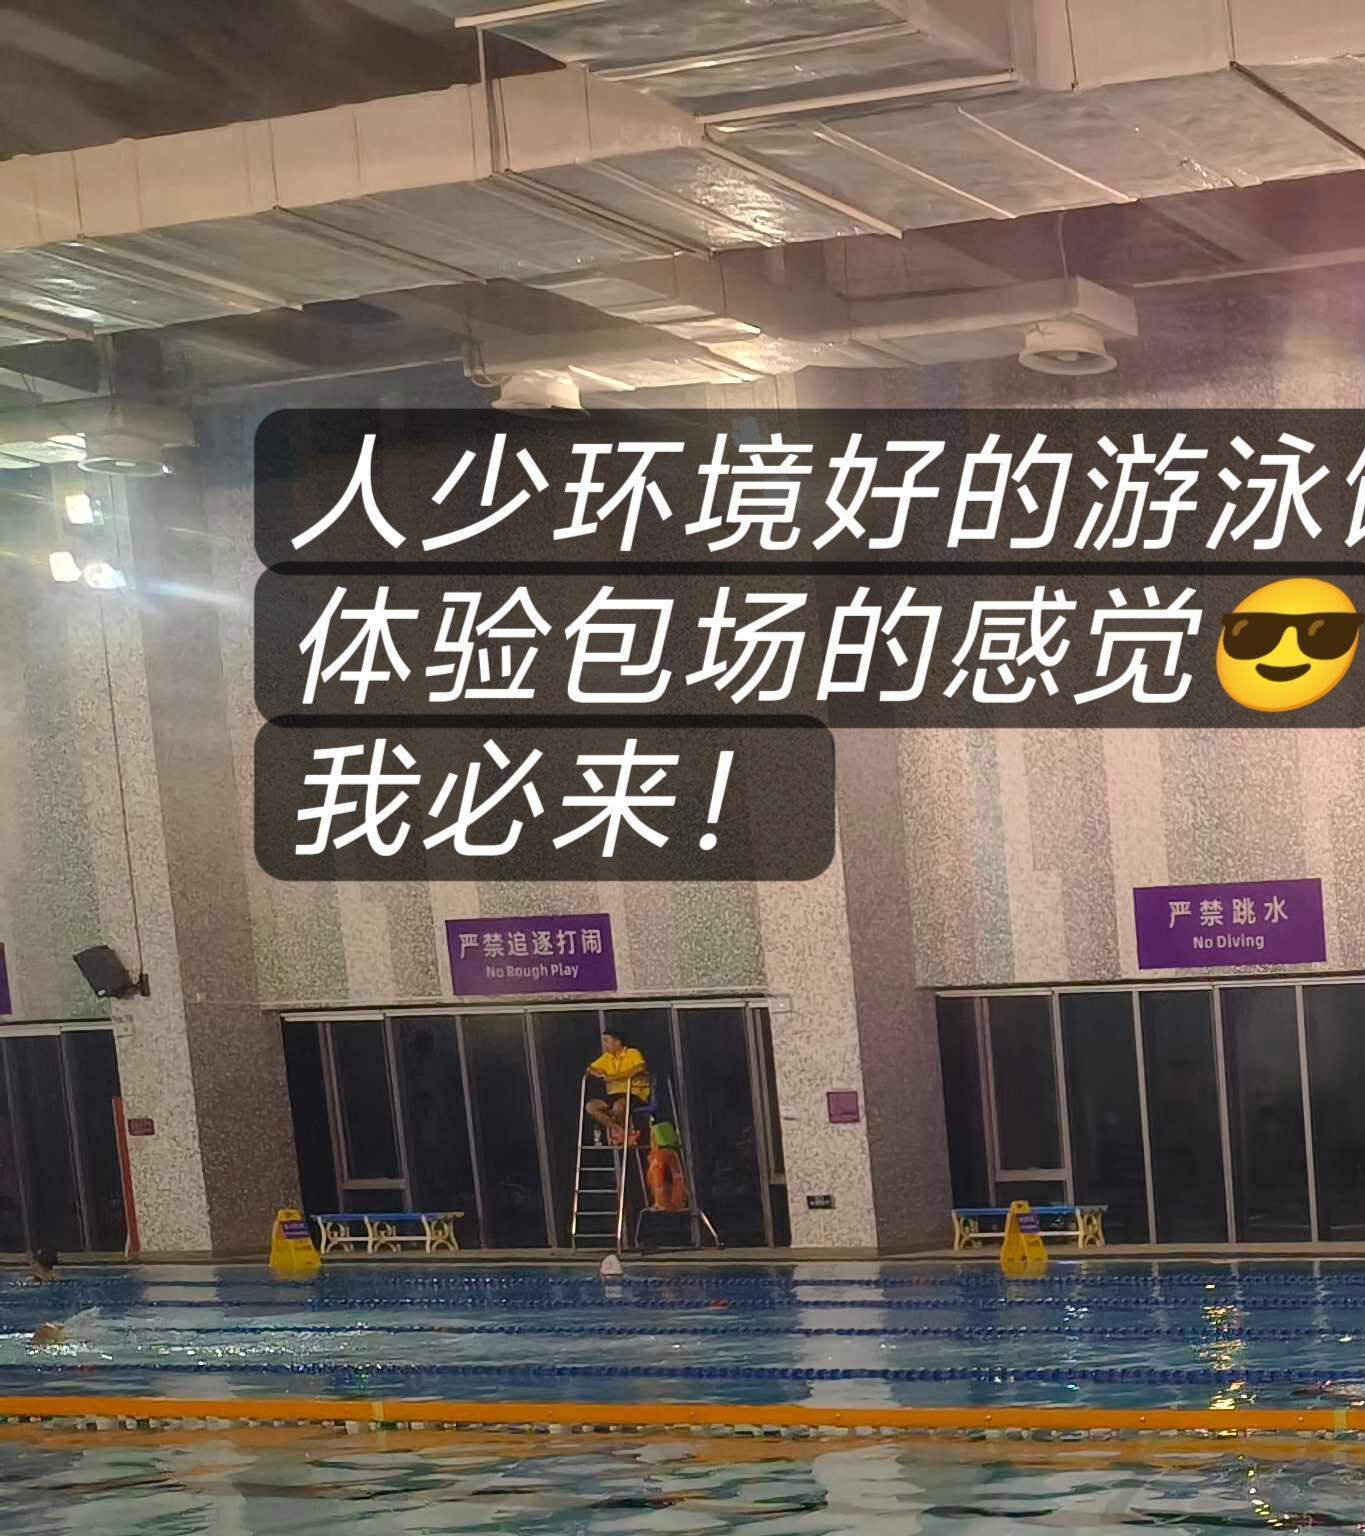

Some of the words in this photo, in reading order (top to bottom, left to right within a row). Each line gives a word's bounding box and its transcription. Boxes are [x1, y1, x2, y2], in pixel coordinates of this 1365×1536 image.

[1168, 895, 1289, 929] 严禁跳水
[458, 928, 603, 959] 严禁追逐打闹
[1193, 936, 1213, 949] No
[1216, 933, 1265, 950] Diving
[486, 965, 504, 979] No
[506, 963, 548, 980] Rough
[551, 962, 579, 979] Play
